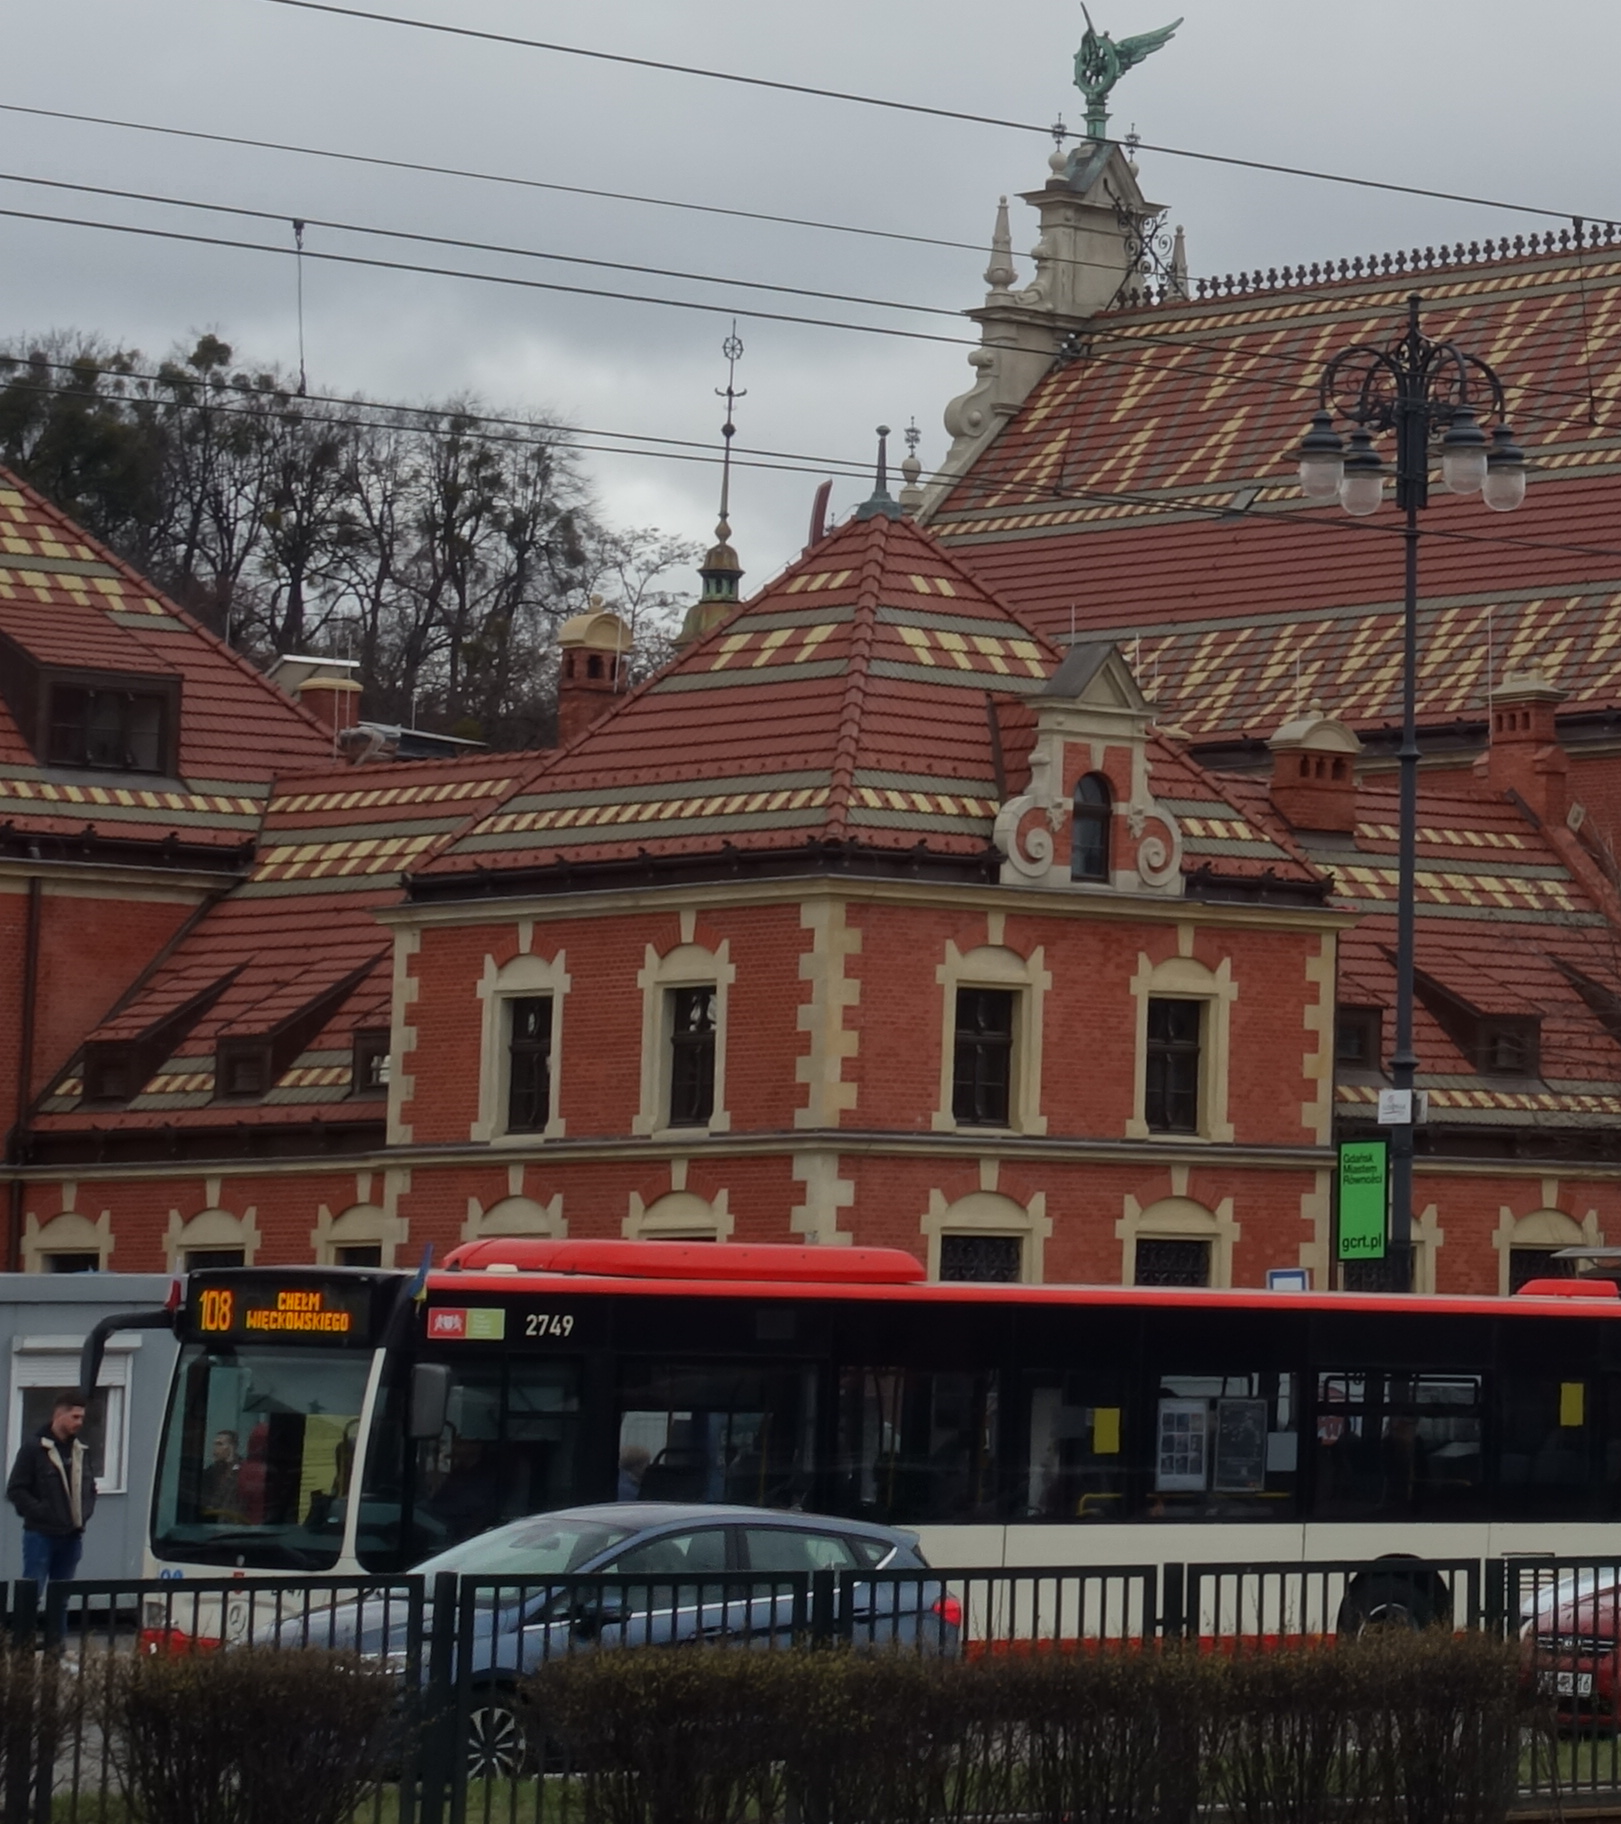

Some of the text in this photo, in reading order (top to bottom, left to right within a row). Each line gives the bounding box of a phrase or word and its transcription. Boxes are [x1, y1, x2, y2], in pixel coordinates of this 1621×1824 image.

[1343, 1153, 1374, 1163] Gdańsk
[1342, 1232, 1381, 1252] gcrt.pl
[199, 1290, 233, 1331] 108
[277, 1292, 321, 1311] CHEŁM
[246, 1310, 349, 1331] WIĘCKOWSKIEGO
[525, 1314, 574, 1337] 2749
